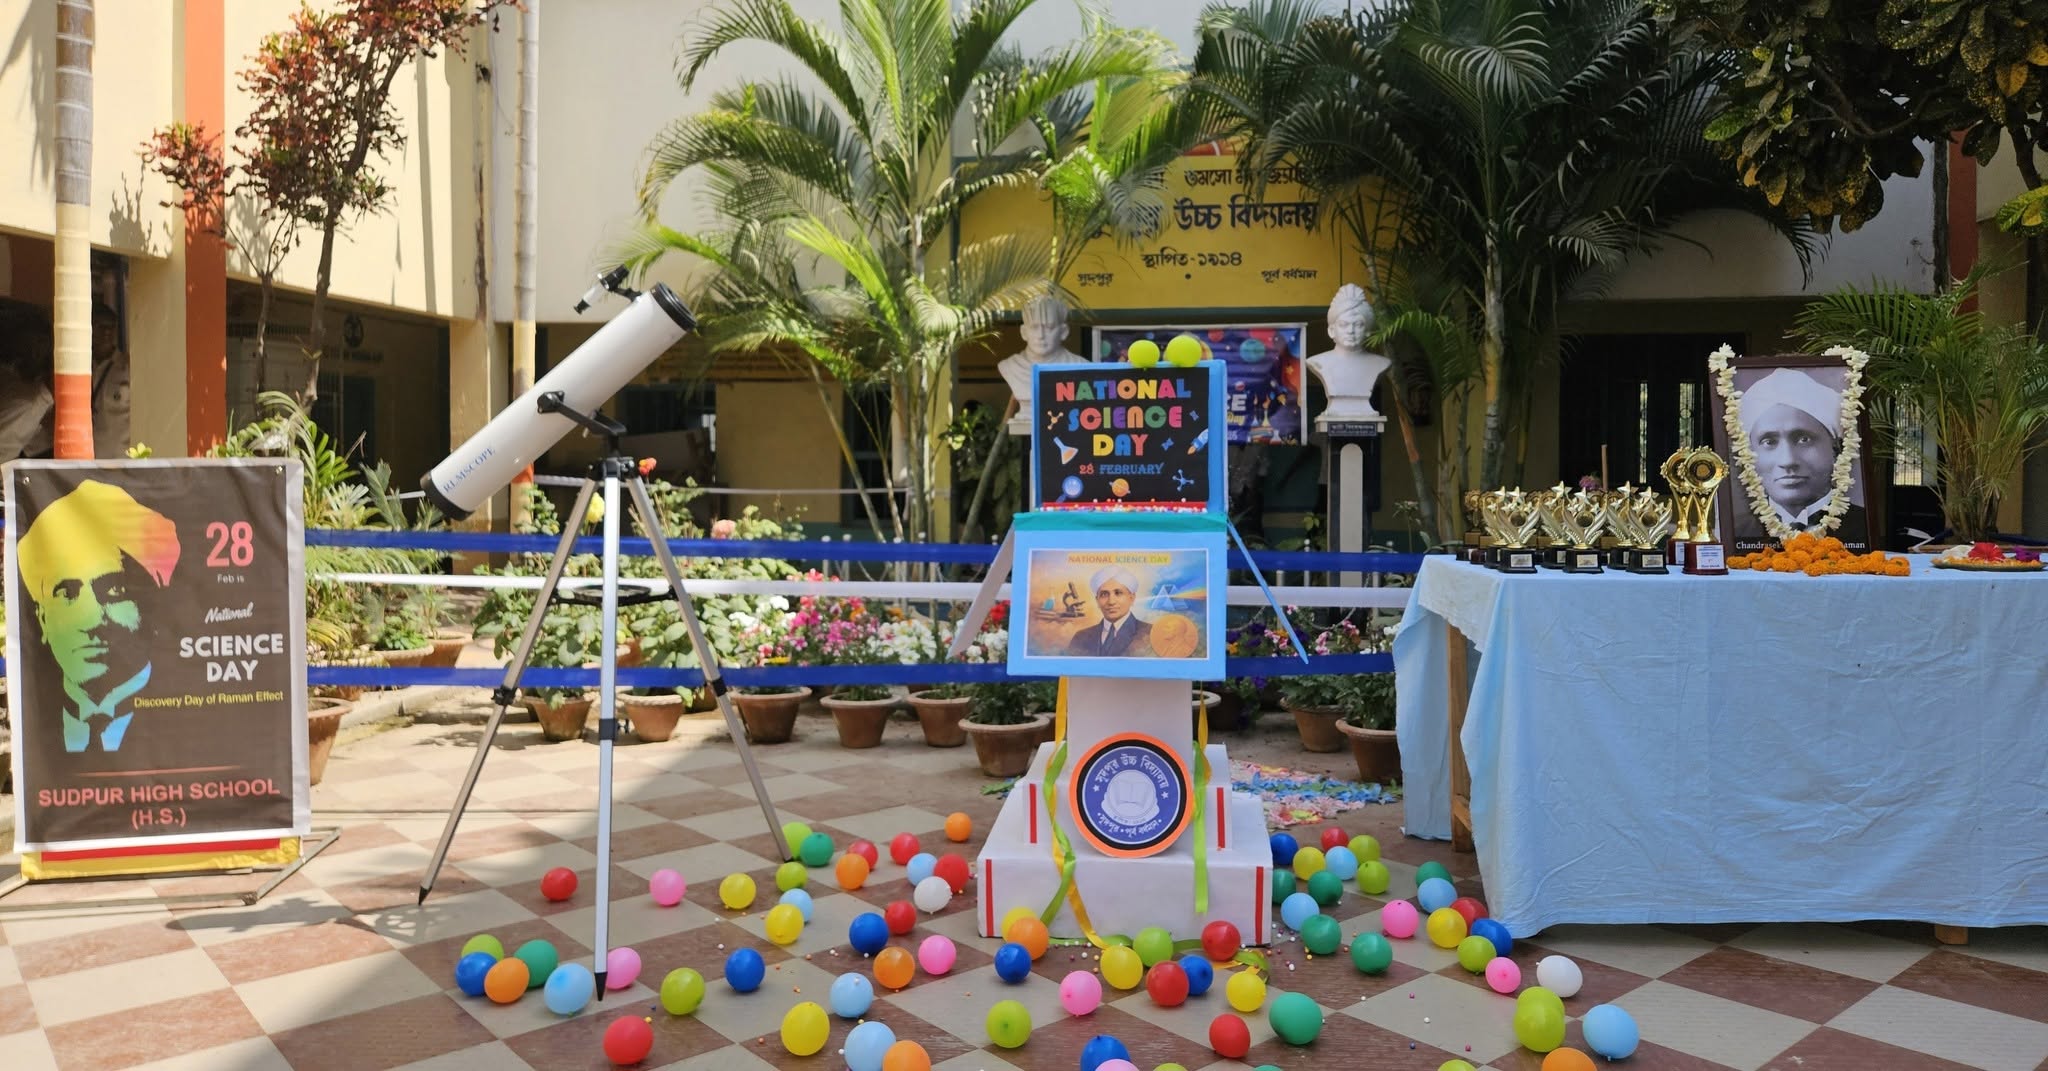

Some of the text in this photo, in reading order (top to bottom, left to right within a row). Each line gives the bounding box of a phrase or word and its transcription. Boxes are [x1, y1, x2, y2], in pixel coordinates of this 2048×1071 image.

[1173, 197, 1222, 231] উচ্চ
[1228, 194, 1320, 231] বিদ্যালয়
[1056, 378, 1191, 401] NATIONAL
[1067, 405, 1183, 432] SCIENCE
[1093, 433, 1148, 456] DAY
[1079, 462, 1164, 474] 28 FEBRUARY
[206, 521, 254, 567] 28
[1068, 555, 1112, 563] NATIONAL
[1115, 555, 1147, 563] SCIENCE
[217, 572, 244, 583] Feb is
[205, 602, 253, 624] National
[180, 633, 284, 658] SCIENCE
[206, 659, 258, 683] DAY
[134, 690, 284, 709] Discovery Day of Raman Effect
[1120, 753, 1138, 766] উচ্চ
[38, 778, 281, 808] SUDPUR HIGH SCHOOL
[131, 807, 187, 830] (H.S.)
